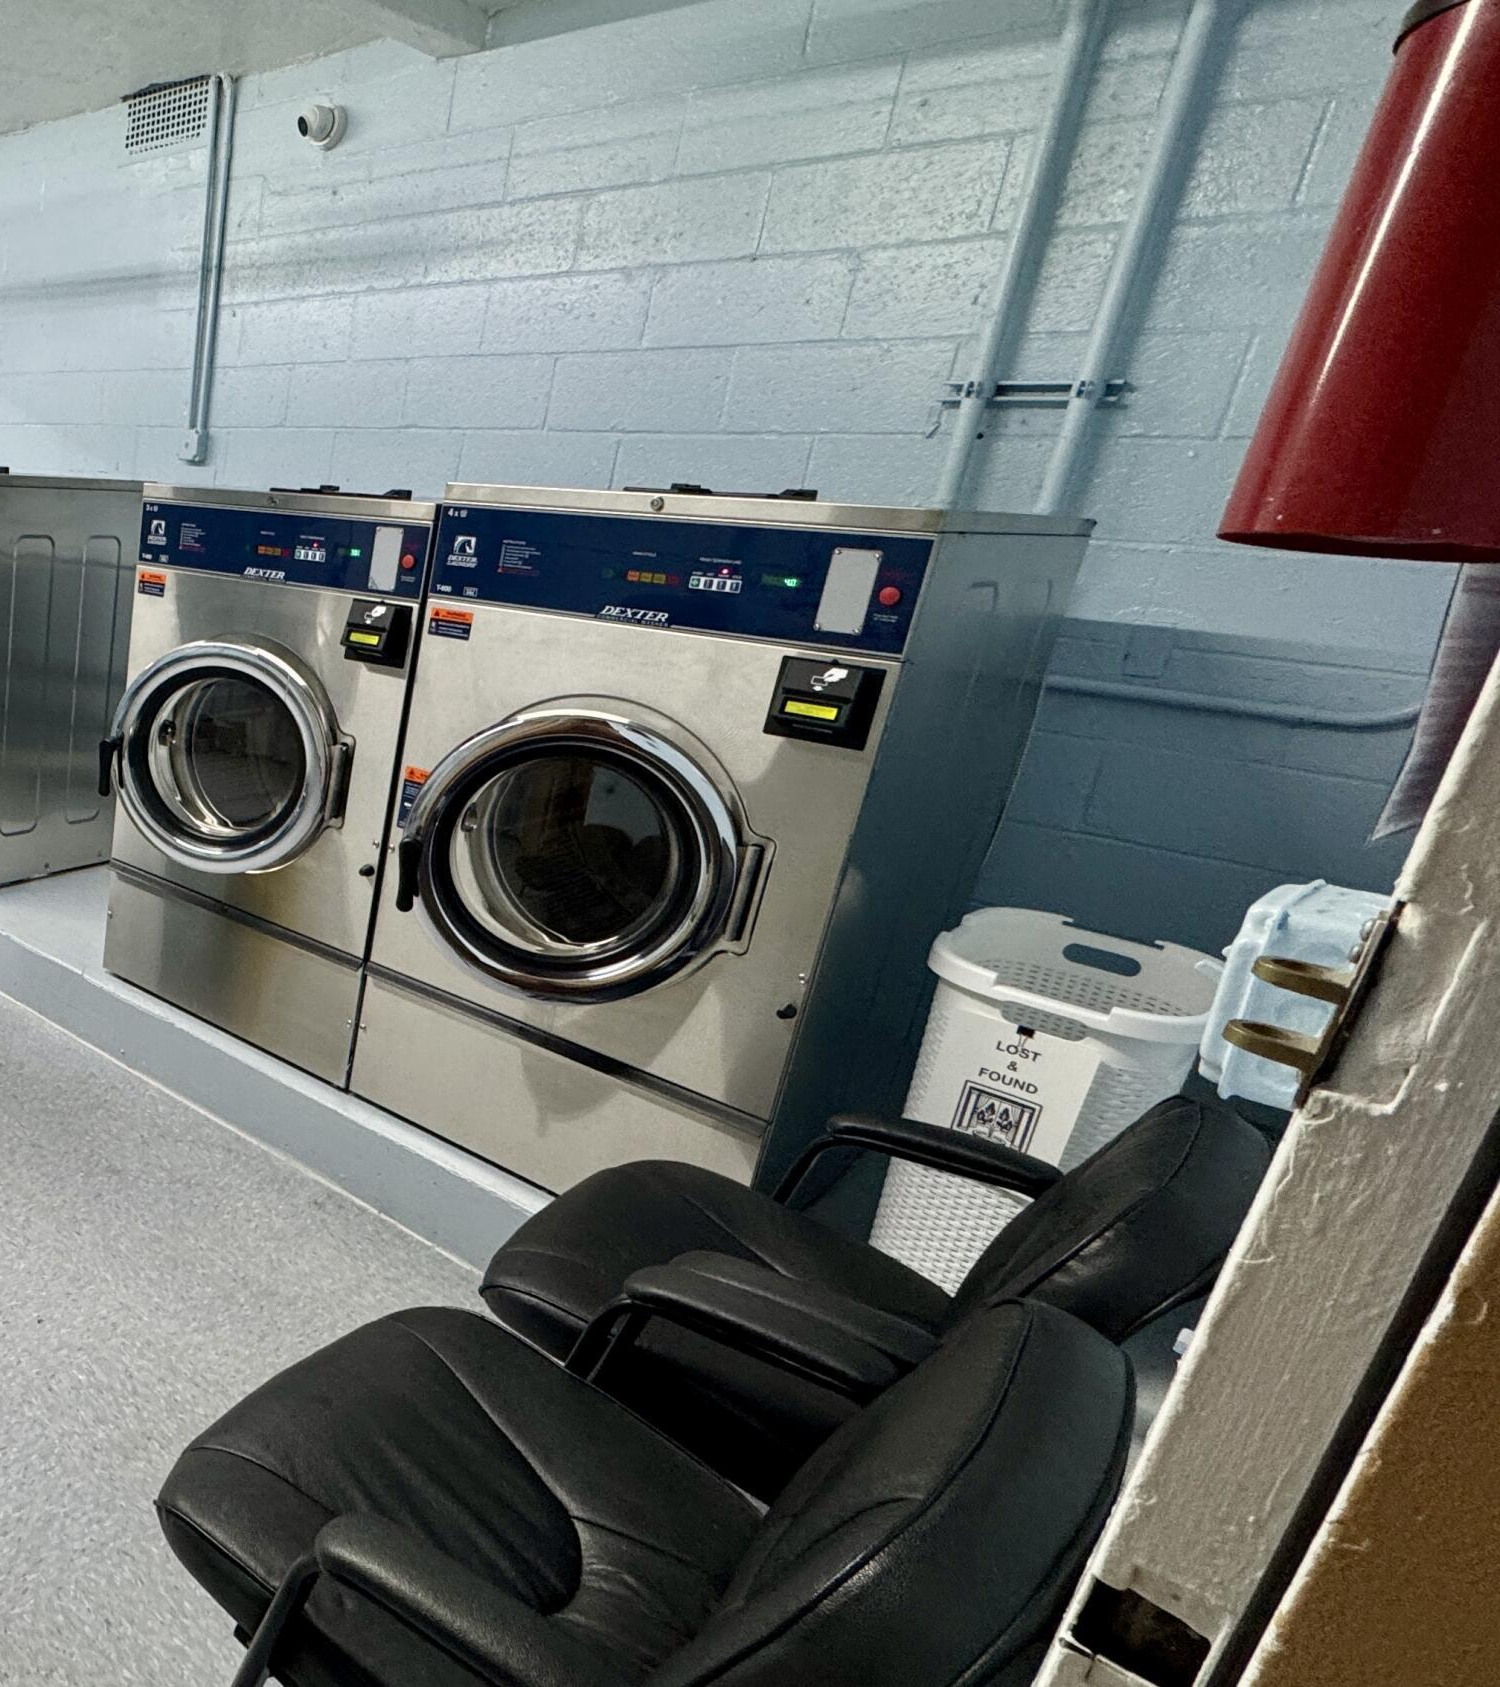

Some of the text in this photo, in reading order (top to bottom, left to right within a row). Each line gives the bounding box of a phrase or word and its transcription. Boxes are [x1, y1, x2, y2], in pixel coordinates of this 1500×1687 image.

[243, 566, 286, 580] DEXTER
[599, 605, 669, 622] DEXTER
[996, 1040, 1042, 1062] LOST
[1007, 1061, 1018, 1073] &
[978, 1067, 1039, 1095] FOUND
